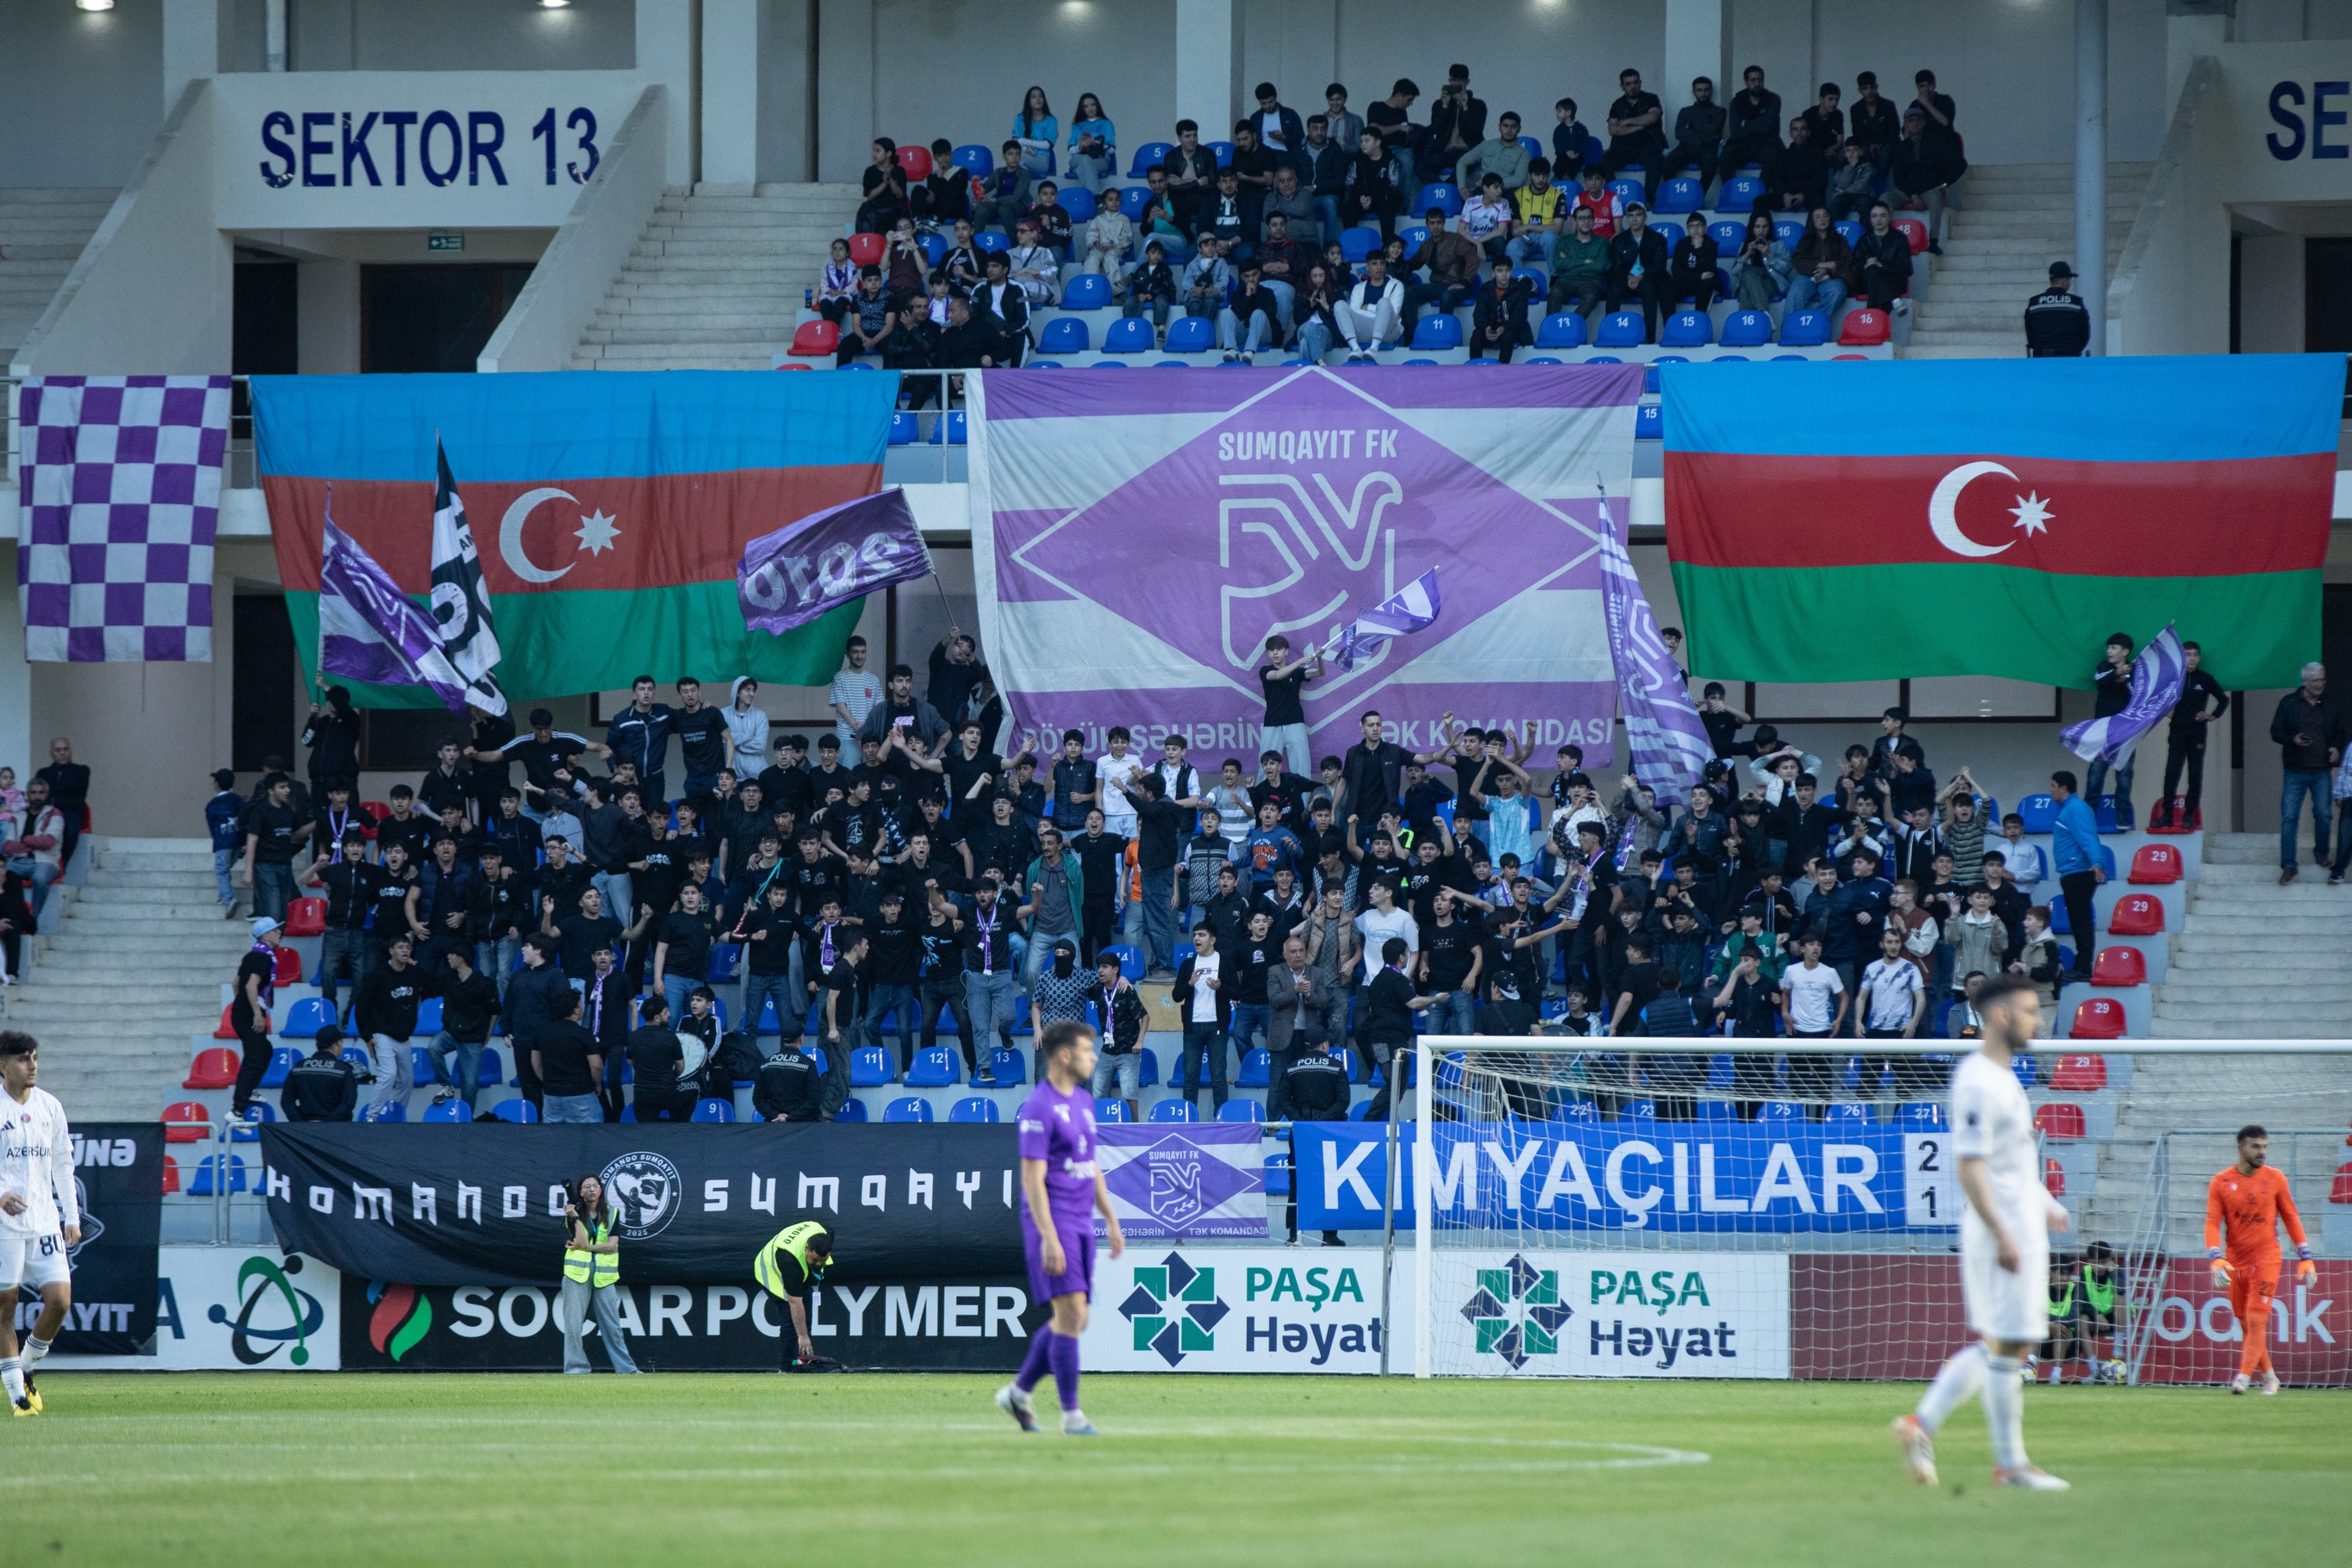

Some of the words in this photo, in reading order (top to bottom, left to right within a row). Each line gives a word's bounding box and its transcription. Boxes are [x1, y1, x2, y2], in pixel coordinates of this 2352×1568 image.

[2267, 81, 2350, 161] SE
[260, 110, 508, 188] SEKTOR
[533, 107, 600, 185] 13
[1154, 148, 1160, 157] 5
[1216, 146, 1223, 156] 6
[908, 152, 912, 160] 1
[969, 151, 975, 159] 2
[1615, 184, 1628, 195] 13
[1675, 183, 1687, 192] 14
[1738, 183, 1749, 191] 15
[1132, 192, 1138, 202] 5
[1434, 189, 1445, 198] 10
[1414, 232, 1425, 240] 10
[1720, 227, 1732, 236] 15
[1778, 227, 1789, 236] 16
[862, 238, 867, 246] 1
[923, 237, 930, 246] 2
[986, 236, 992, 246] 3
[1086, 279, 1092, 289] 5
[1434, 320, 1442, 329] 11
[1617, 317, 1628, 327] 14
[1683, 317, 1694, 327] 15
[1742, 315, 1754, 325] 16
[1801, 316, 1813, 325] 17
[816, 325, 821, 334] 1
[1129, 322, 1135, 331] 6
[1191, 322, 1197, 332] 7
[957, 414, 963, 422] 4
[1645, 408, 1657, 418] 15
[894, 415, 900, 424] 3
[1219, 430, 1355, 464] SUMQAYIT
[1366, 428, 1398, 459] FK
[1378, 720, 1421, 747] ƏK
[2036, 799, 2050, 808] 27
[2152, 851, 2167, 861] 29
[307, 906, 312, 915] 1
[2133, 901, 2147, 912] 29
[1552, 1001, 1565, 1011] 21
[2096, 1003, 2109, 1013] 29
[280, 1054, 287, 1064] 2
[865, 1054, 876, 1063] 11
[930, 1053, 943, 1063] 12
[996, 1052, 1009, 1062] 13
[184, 1106, 190, 1116] 1
[710, 1104, 716, 1113] 9
[6, 1146, 52, 1159] AZERSUN
[1148, 1151, 1186, 1160] SUMQAYIT
[1190, 1150, 1199, 1159] FK
[1918, 1140, 1939, 1172] 2
[640, 1154, 676, 1180] SUMQAYIT
[1921, 1185, 1938, 1217] 1
[784, 1223, 810, 1245] PHOTO
[1189, 1227, 1208, 1235] TƏK
[1210, 1226, 1268, 1235] KOMANDASI
[1247, 1266, 1364, 1314] PAŞA
[1590, 1270, 1711, 1316] PAŞA
[1246, 1316, 1384, 1366] Həyat
[1590, 1320, 1737, 1370] Həyat
